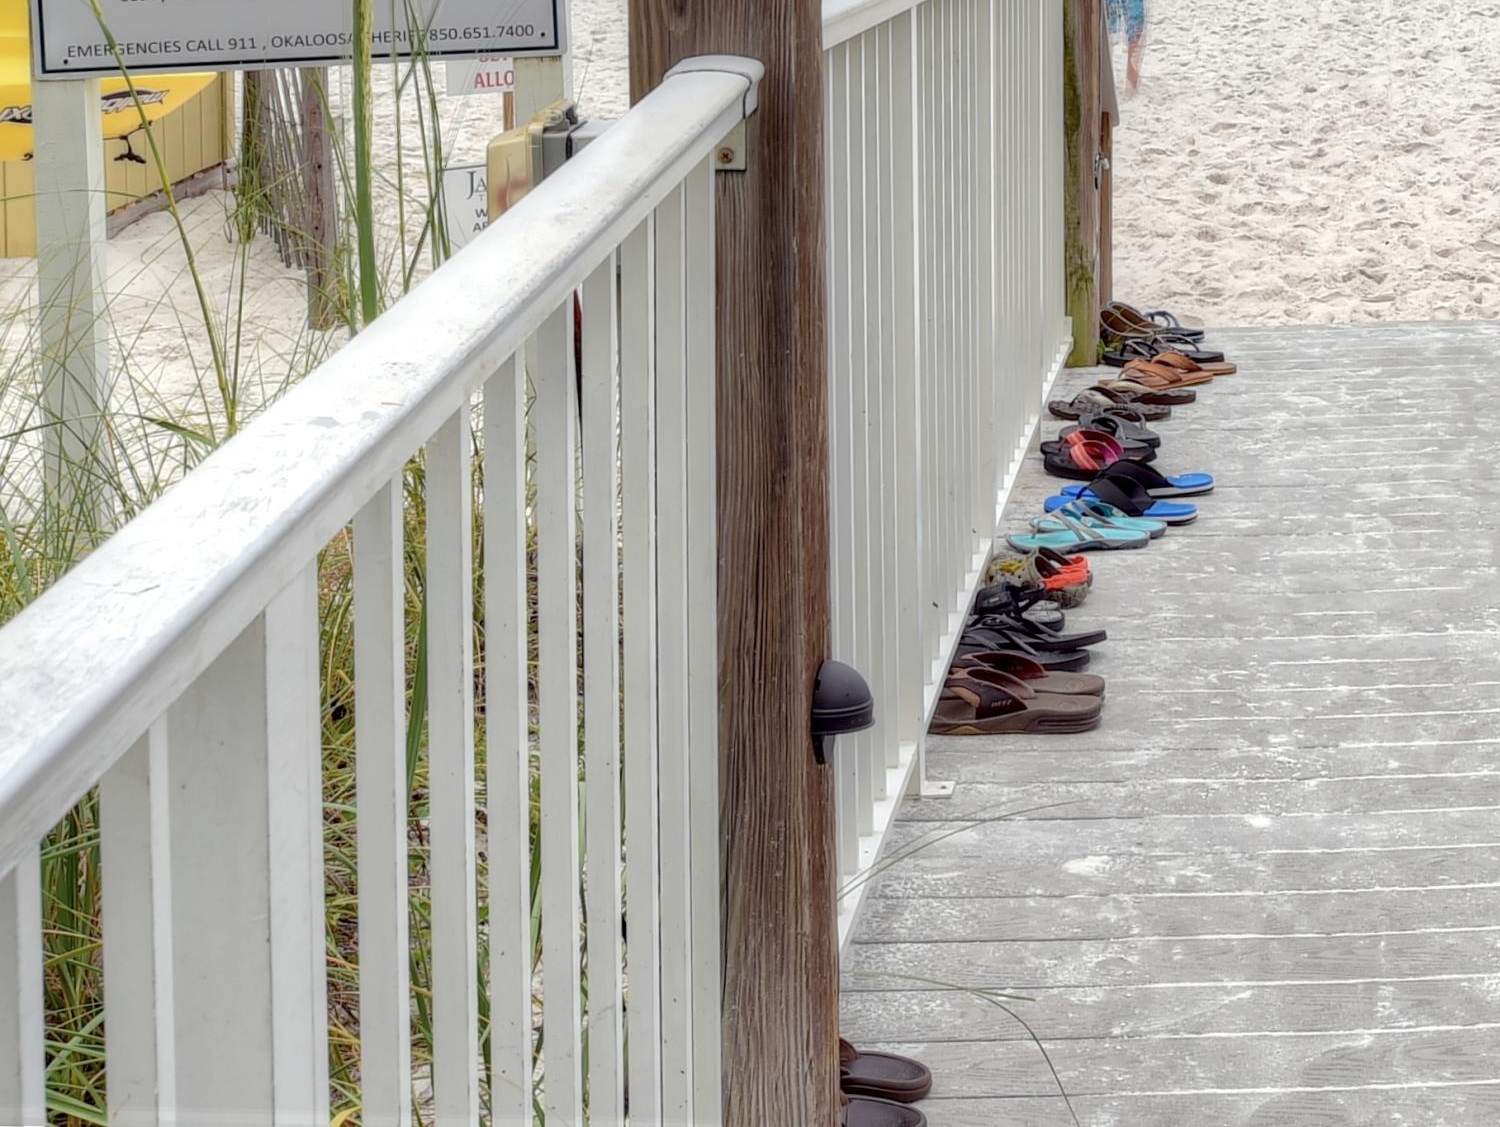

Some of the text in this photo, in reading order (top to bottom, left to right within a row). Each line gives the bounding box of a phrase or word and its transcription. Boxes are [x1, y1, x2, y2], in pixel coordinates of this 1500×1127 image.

[185, 38, 224, 52] CALL
[228, 37, 257, 50] 911
[429, 24, 534, 41] 850.651.7400
